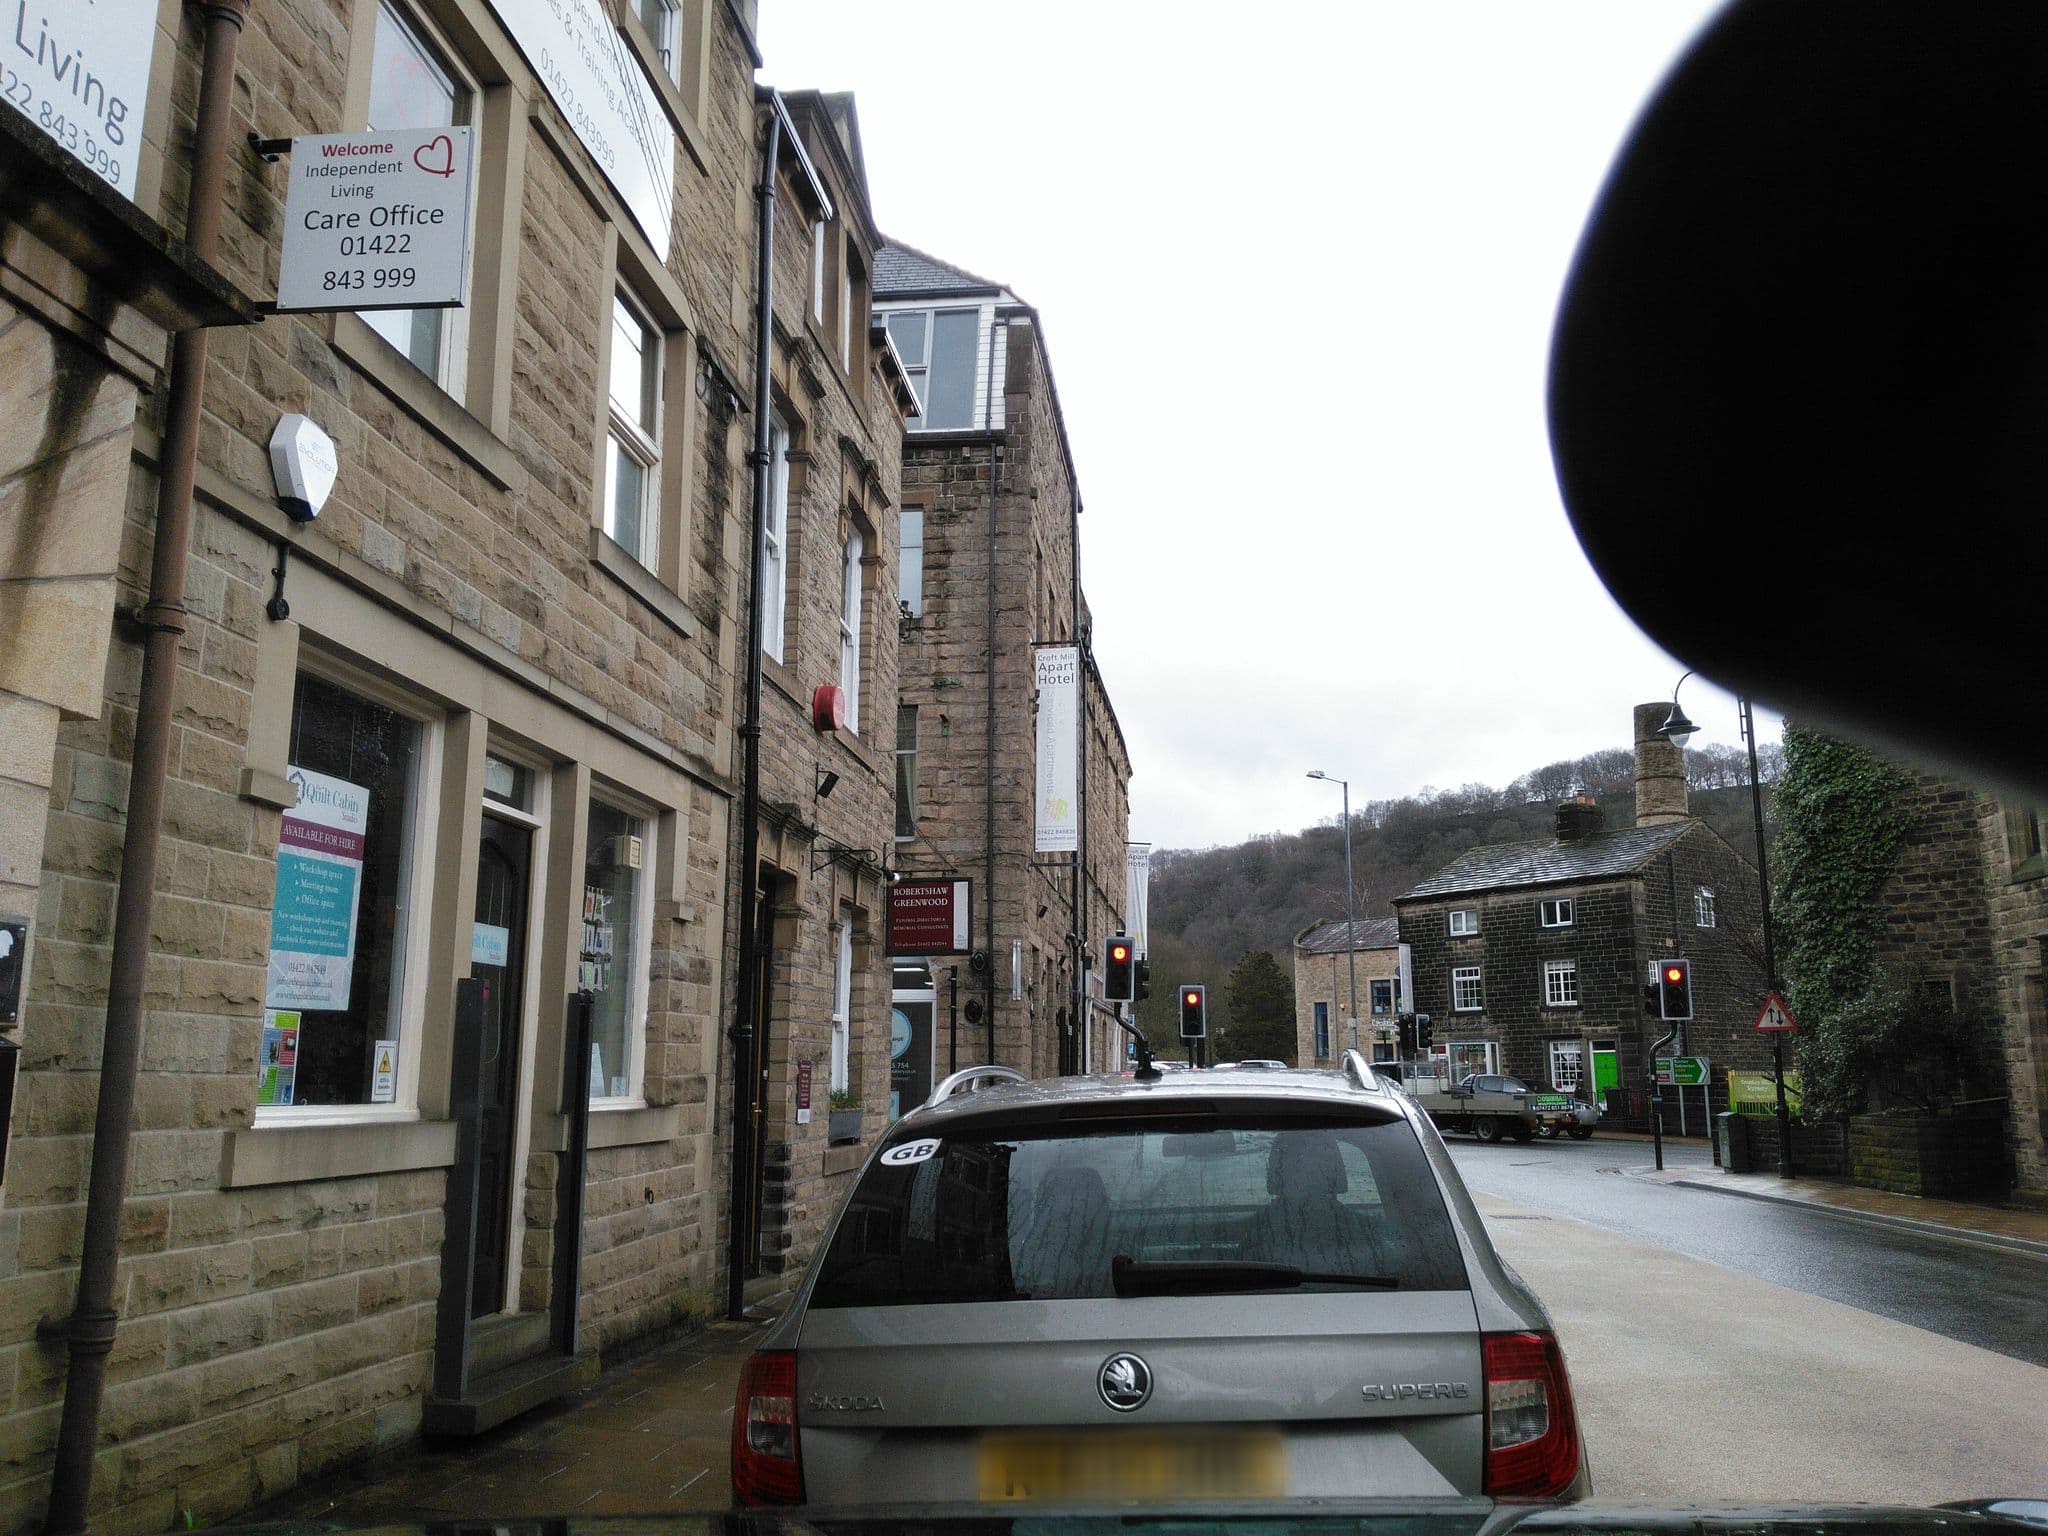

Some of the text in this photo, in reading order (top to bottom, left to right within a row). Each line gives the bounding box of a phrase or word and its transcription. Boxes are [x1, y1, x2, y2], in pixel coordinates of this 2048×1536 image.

[16, 0, 128, 146] Living
[576, 28, 615, 111] Training
[541, 48, 616, 170] 01422 843999
[39, 100, 78, 150] 843
[85, 138, 121, 185] 999
[321, 143, 393, 158] Welcome
[305, 160, 403, 178] Independent
[331, 184, 374, 199] Living
[304, 204, 444, 230] Care Office
[340, 234, 411, 256] 01422
[322, 267, 416, 291] 843 999
[1060, 652, 1075, 660] Mill
[1038, 662, 1074, 673] Apart
[1038, 672, 1074, 685] Hotel
[306, 783, 359, 813] Quilt Cabin
[283, 824, 356, 850] AVAILABLE FOR HIRE
[894, 886, 948, 896] ROBERTSHAW
[894, 898, 948, 907] GREENWOOD
[891, 1144, 934, 1160] GB
[1362, 1382, 1470, 1402] SUPERB
